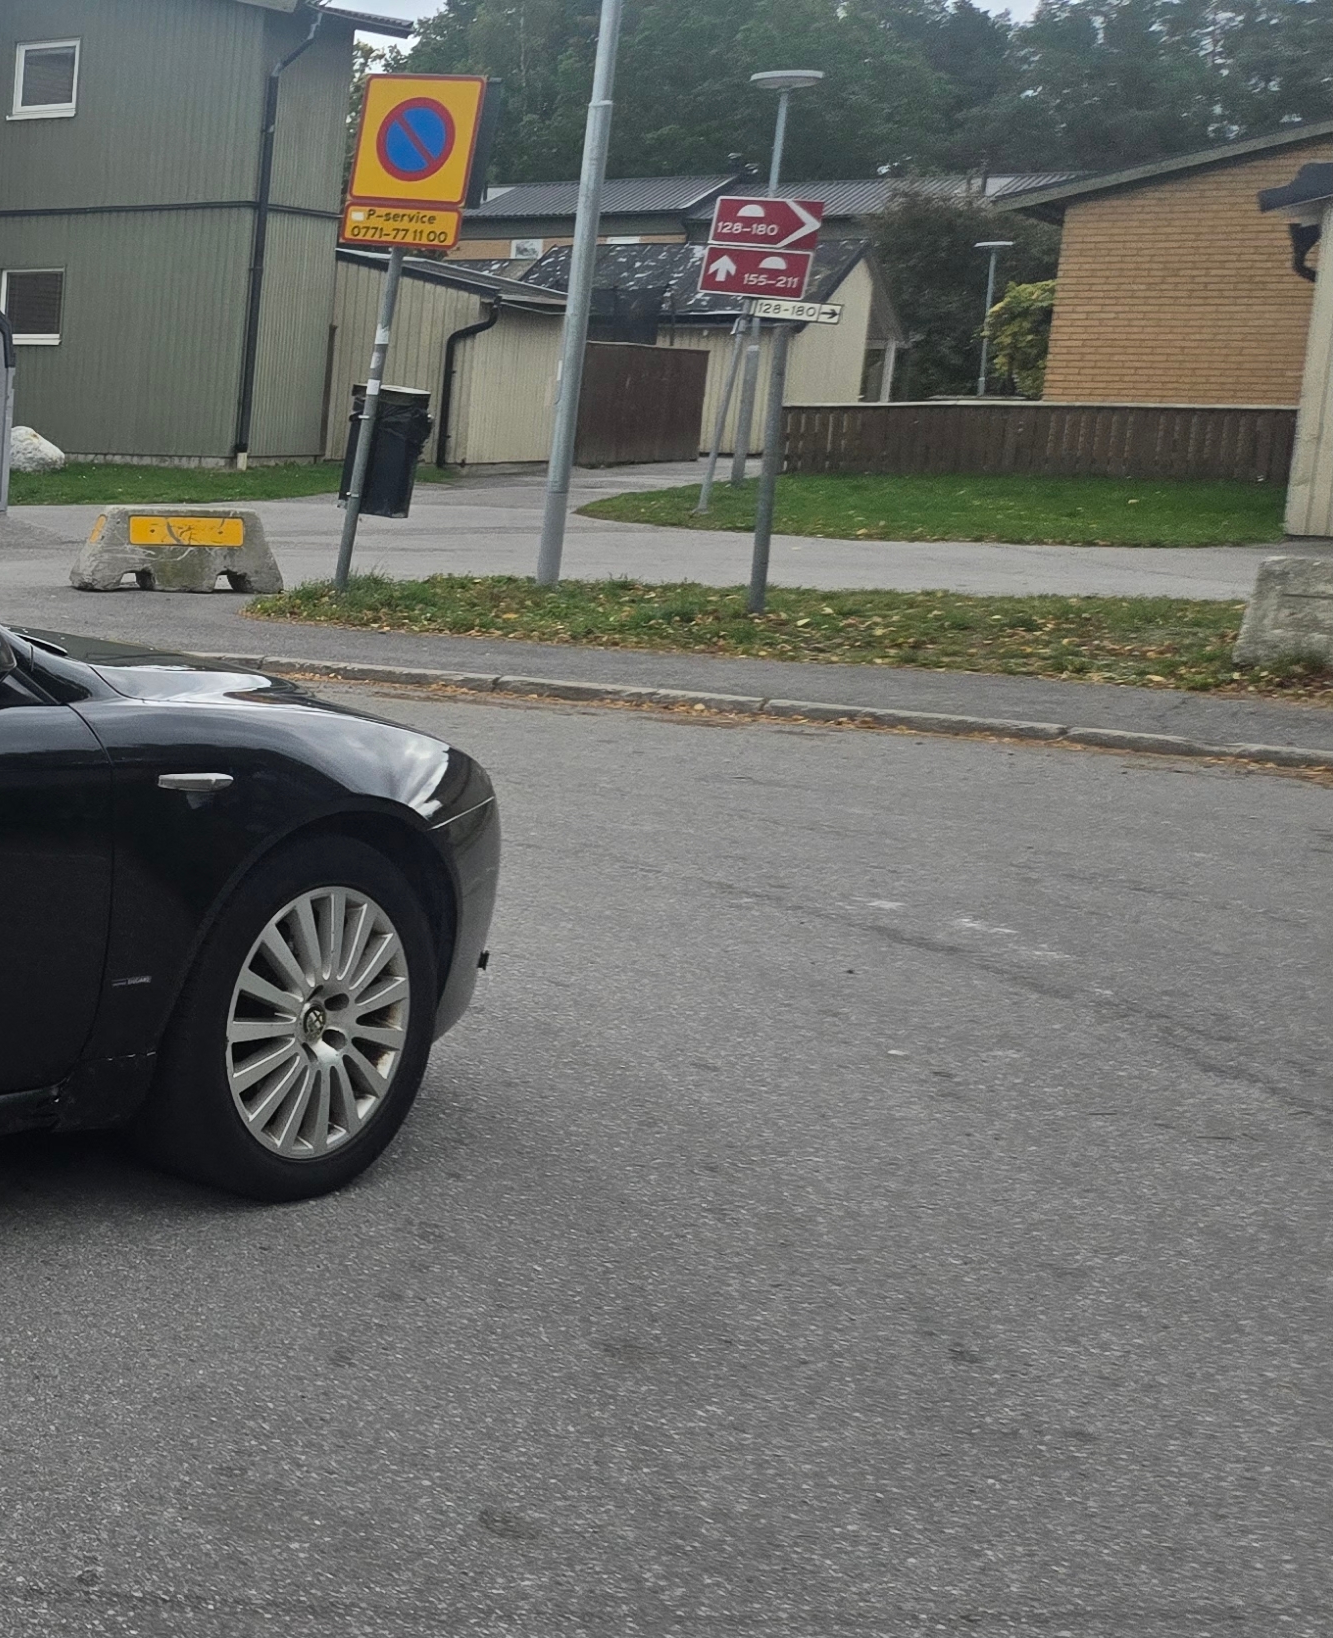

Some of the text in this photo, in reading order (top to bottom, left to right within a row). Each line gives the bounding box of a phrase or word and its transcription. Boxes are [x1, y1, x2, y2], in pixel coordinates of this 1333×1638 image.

[367, 209, 436, 224] P-service
[350, 226, 409, 240] 0771-77
[716, 221, 779, 236] 128-180
[743, 273, 799, 288] 155-211
[758, 302, 817, 317] 128-180
